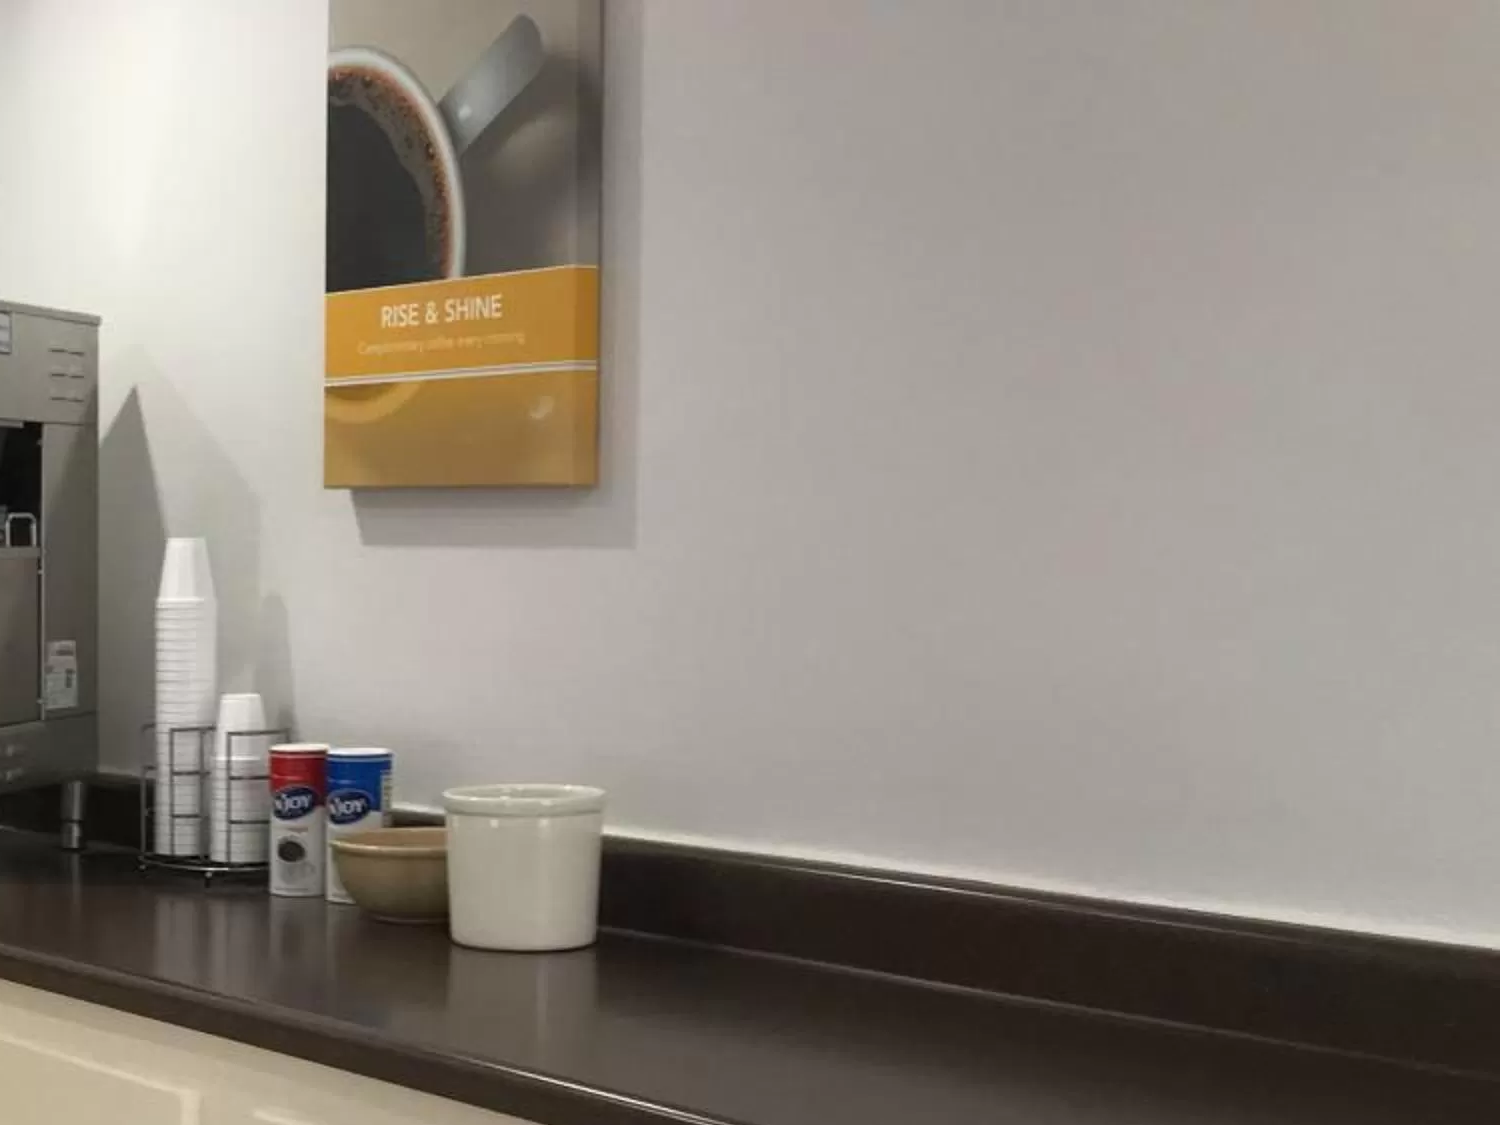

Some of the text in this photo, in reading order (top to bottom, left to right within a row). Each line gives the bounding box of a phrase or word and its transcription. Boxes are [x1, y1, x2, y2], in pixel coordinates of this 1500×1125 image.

[381, 294, 502, 328] RISE & SHINE
